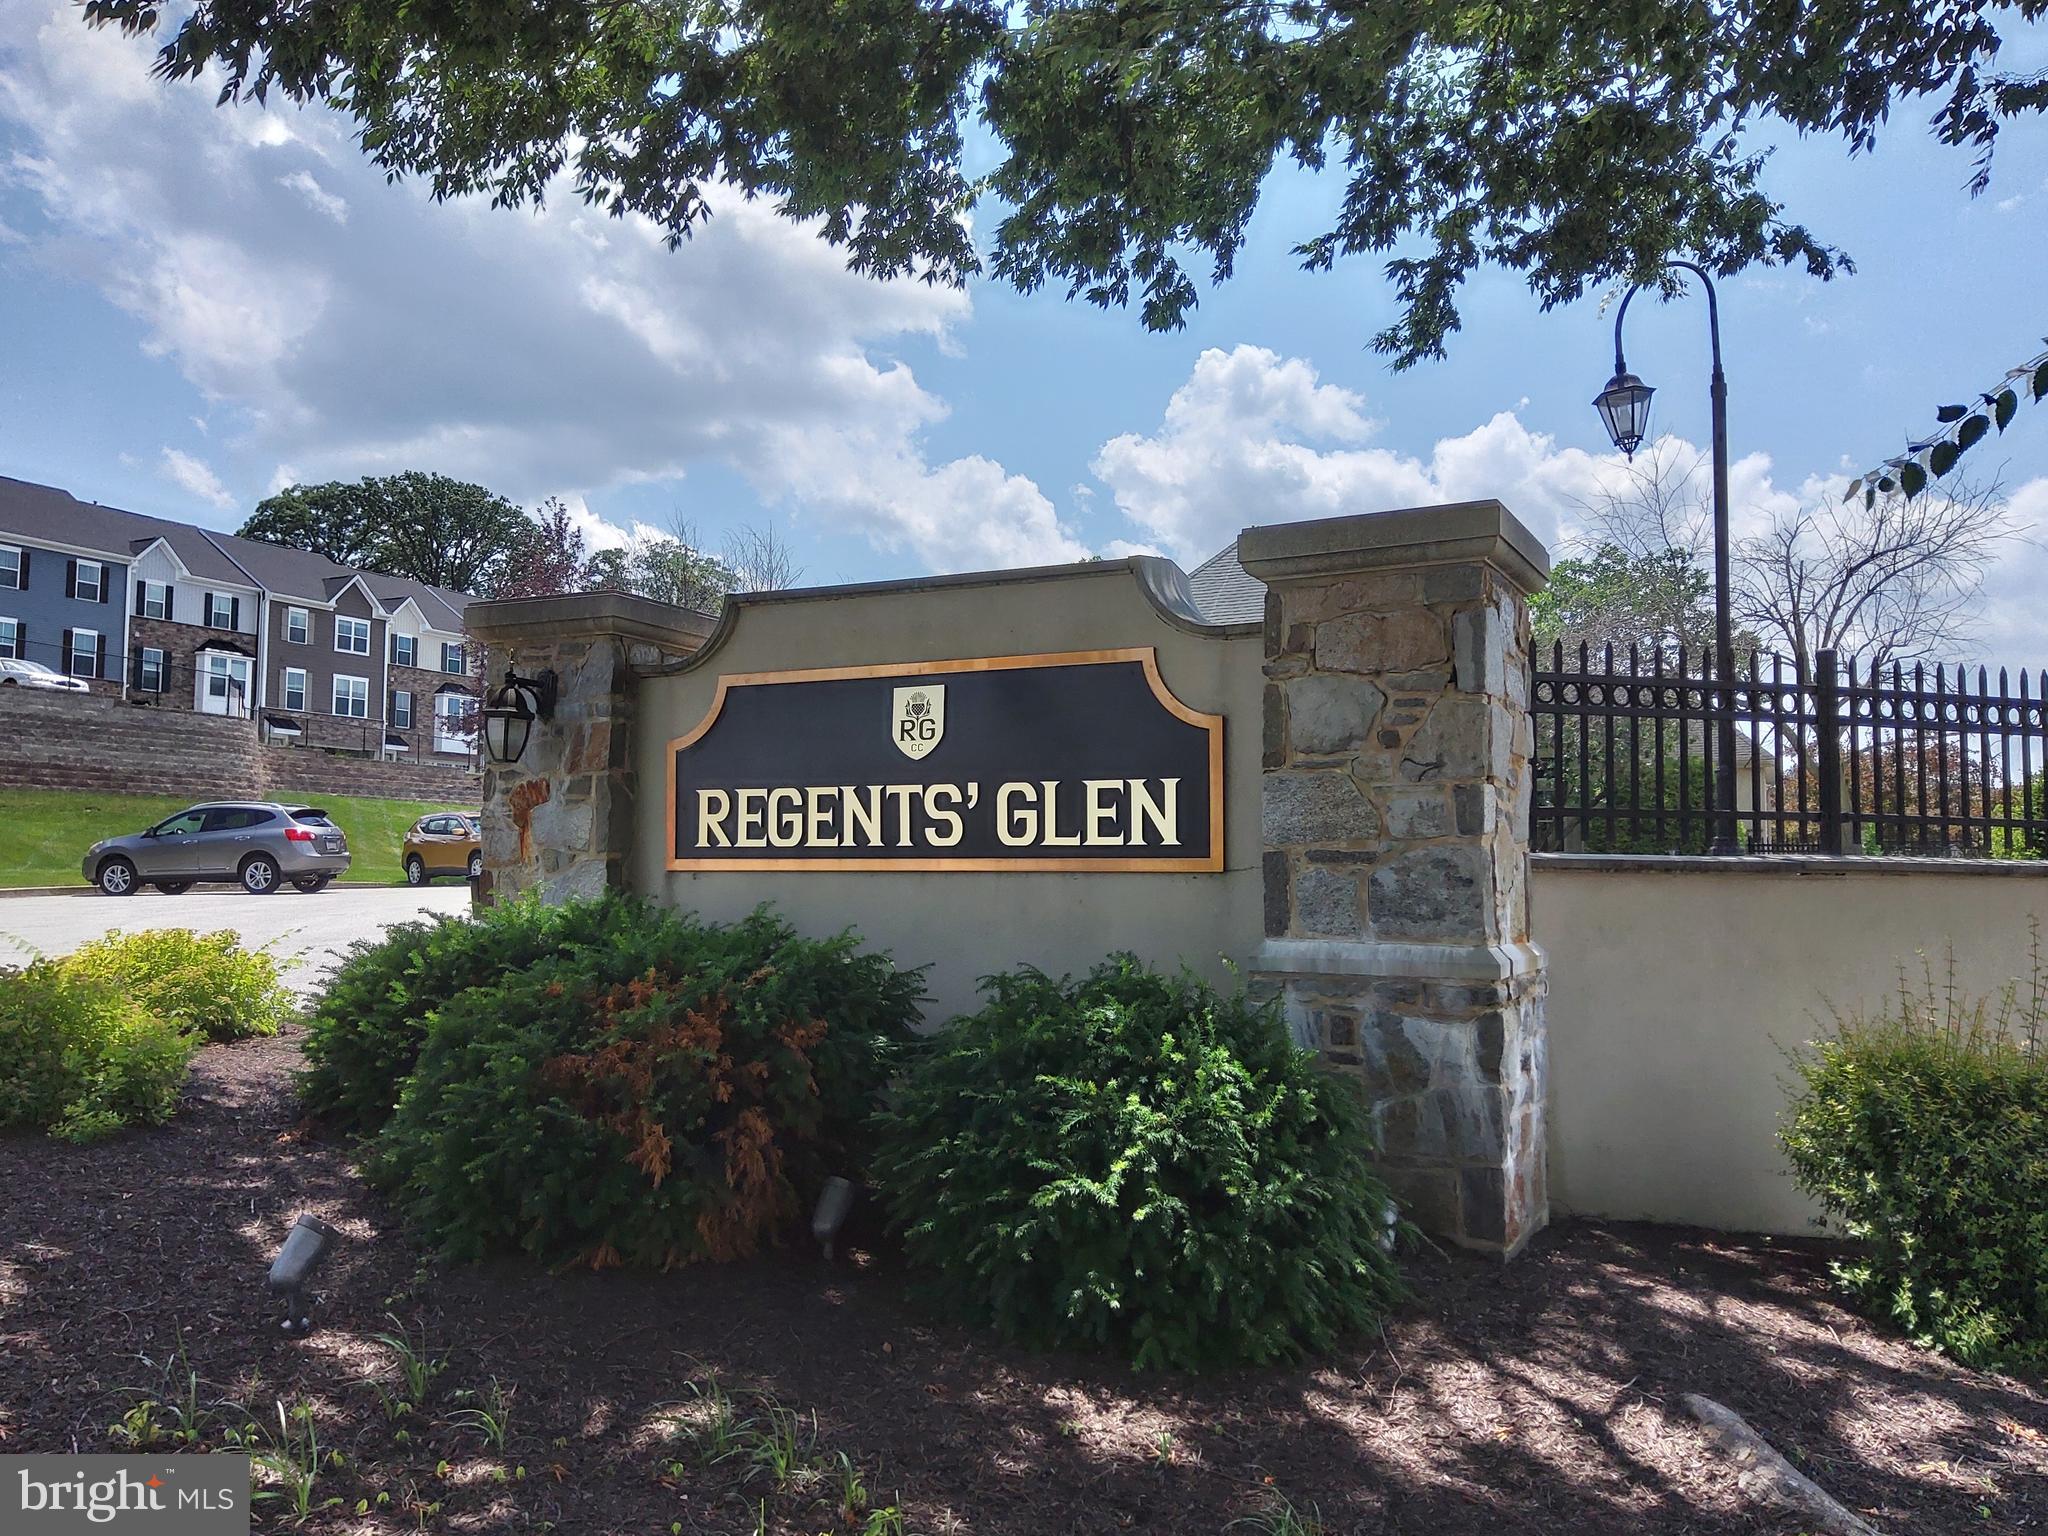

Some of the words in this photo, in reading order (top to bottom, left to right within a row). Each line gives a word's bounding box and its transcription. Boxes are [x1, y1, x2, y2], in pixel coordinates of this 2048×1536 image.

[900, 718, 936, 742] RG
[911, 743, 924, 752] CC
[695, 782, 979, 848] REGENTS'
[996, 777, 1182, 847] GLEN
